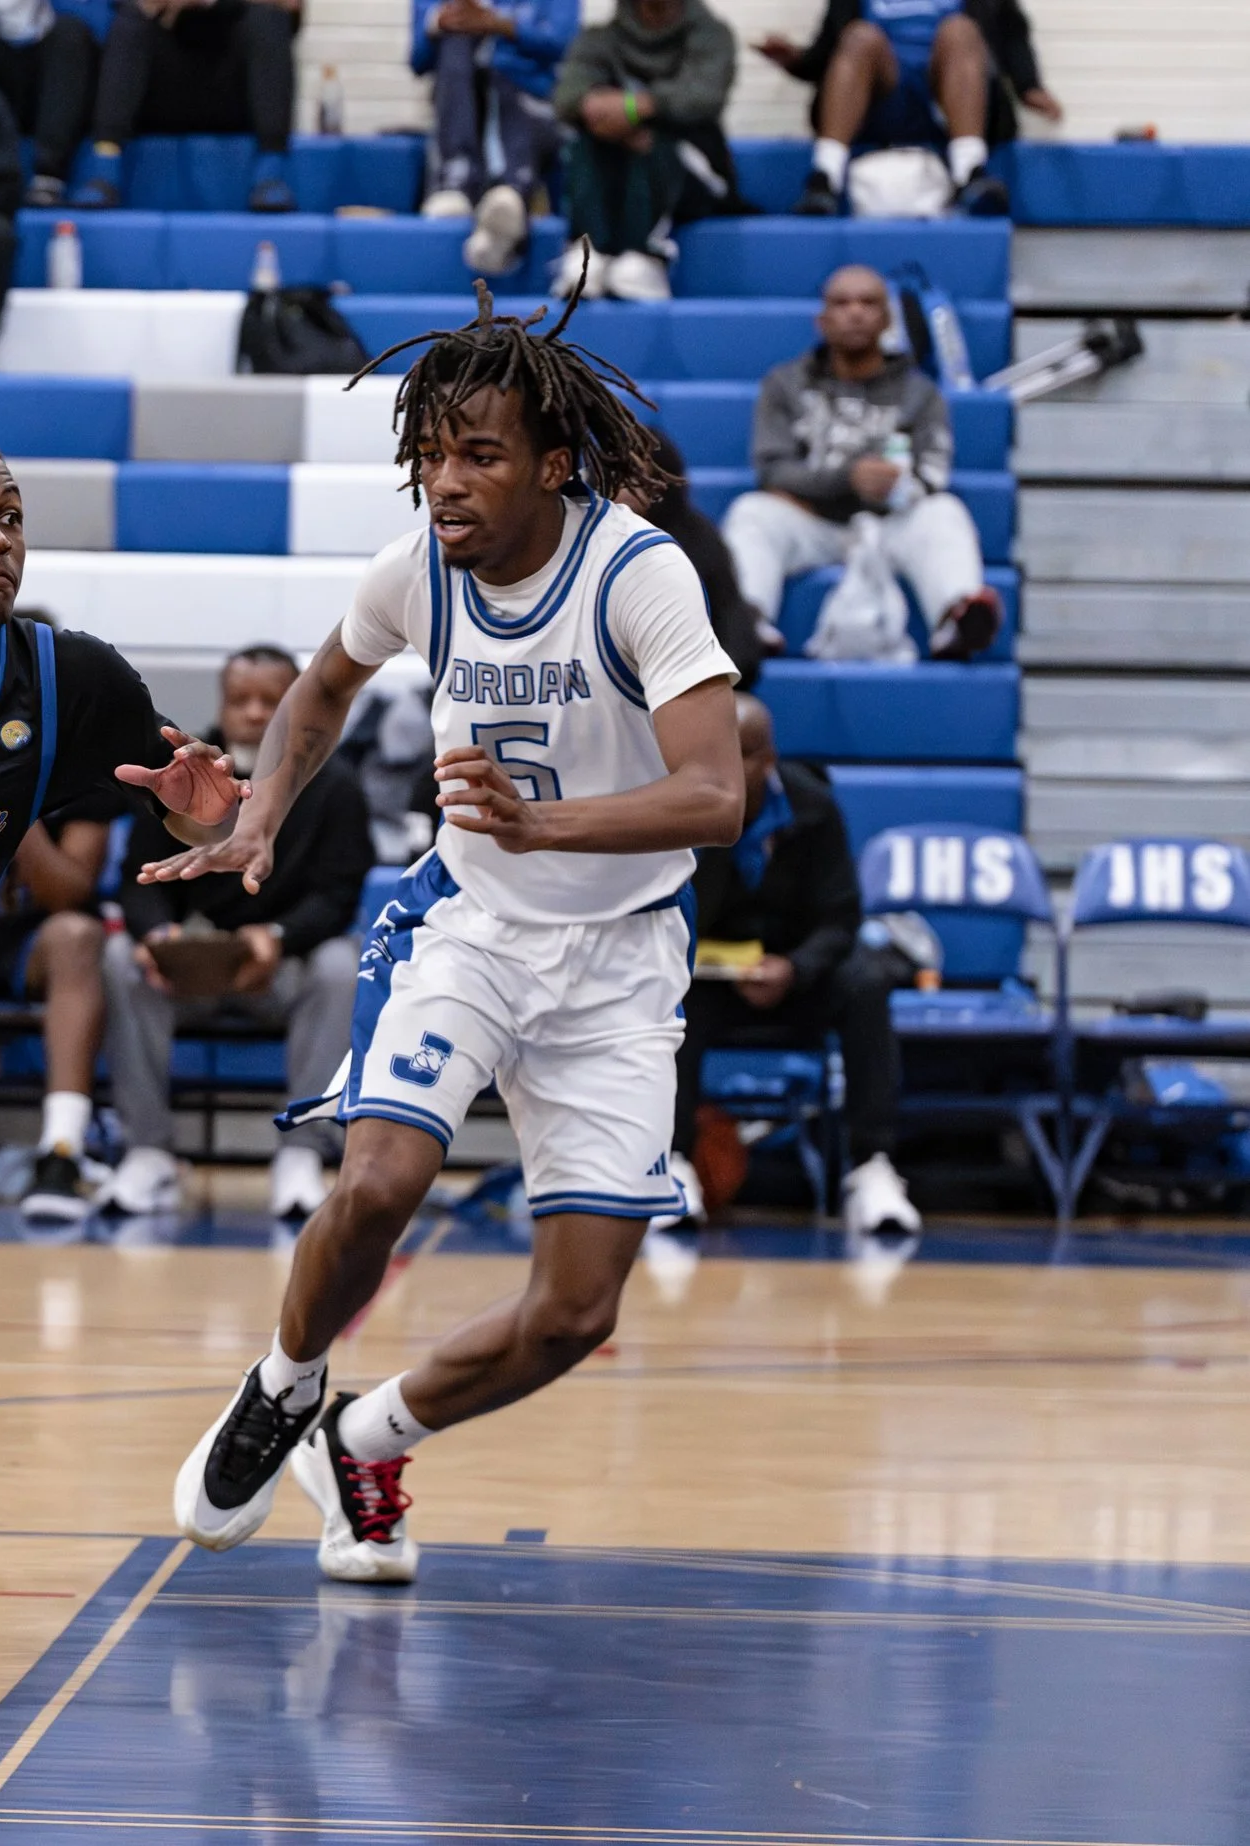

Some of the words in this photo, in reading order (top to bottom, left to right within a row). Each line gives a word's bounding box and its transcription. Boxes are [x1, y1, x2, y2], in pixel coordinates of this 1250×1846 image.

[447, 658, 592, 706] ORDAN
[471, 721, 563, 801] 5
[887, 835, 1015, 905] JHS
[1107, 843, 1235, 912] JHS
